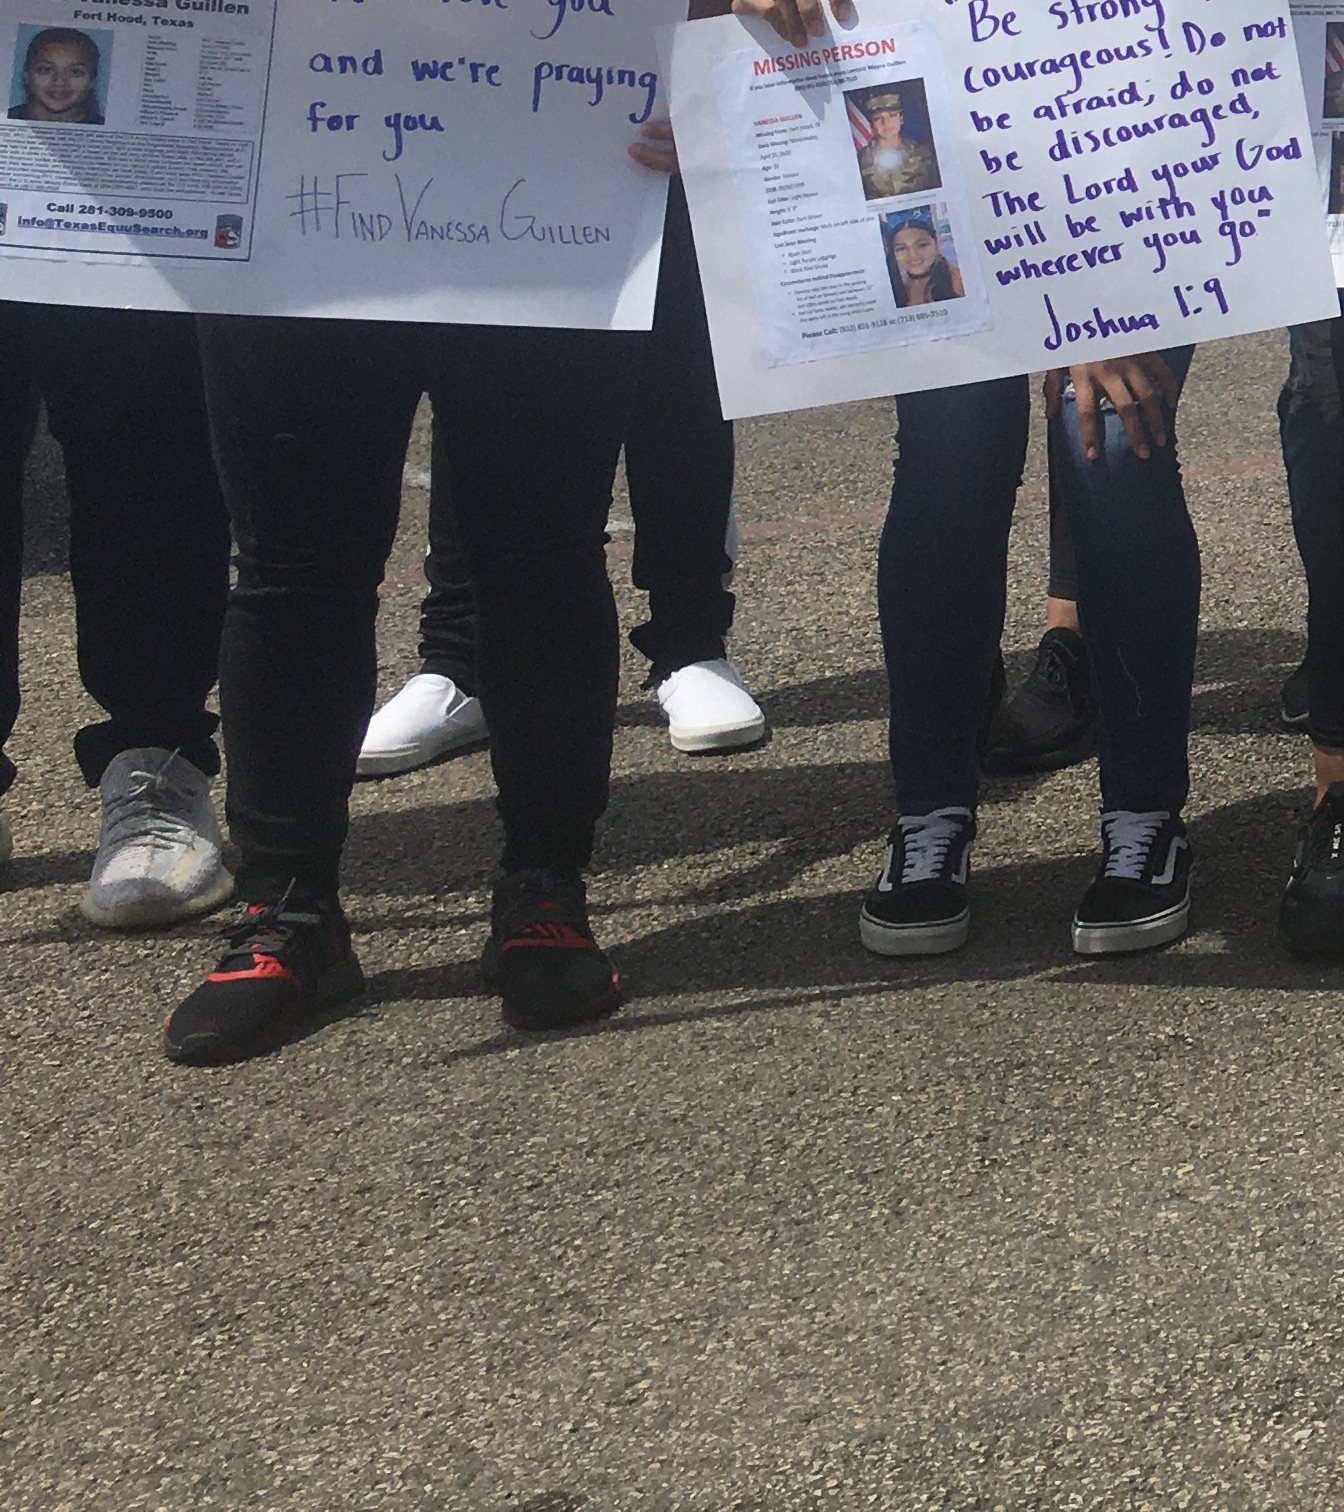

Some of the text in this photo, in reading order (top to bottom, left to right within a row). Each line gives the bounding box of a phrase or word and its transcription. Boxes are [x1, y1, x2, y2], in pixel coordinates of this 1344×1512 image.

[753, 38, 896, 76] MISSING PERSON
[1183, 23, 1226, 54] Do
[1244, 16, 1287, 41] not
[309, 48, 657, 124] and we're praying
[971, 109, 1012, 134] be
[1169, 71, 1214, 99] do
[1230, 60, 1282, 85] not
[306, 103, 445, 161] for you
[981, 96, 1259, 175] be discouraged,
[982, 136, 1303, 220] The Lord your God
[985, 184, 1273, 257] will be with you
[996, 241, 1124, 286] wherever
[1142, 230, 1201, 274] you
[1044, 278, 1229, 350] Joshua 1:9
